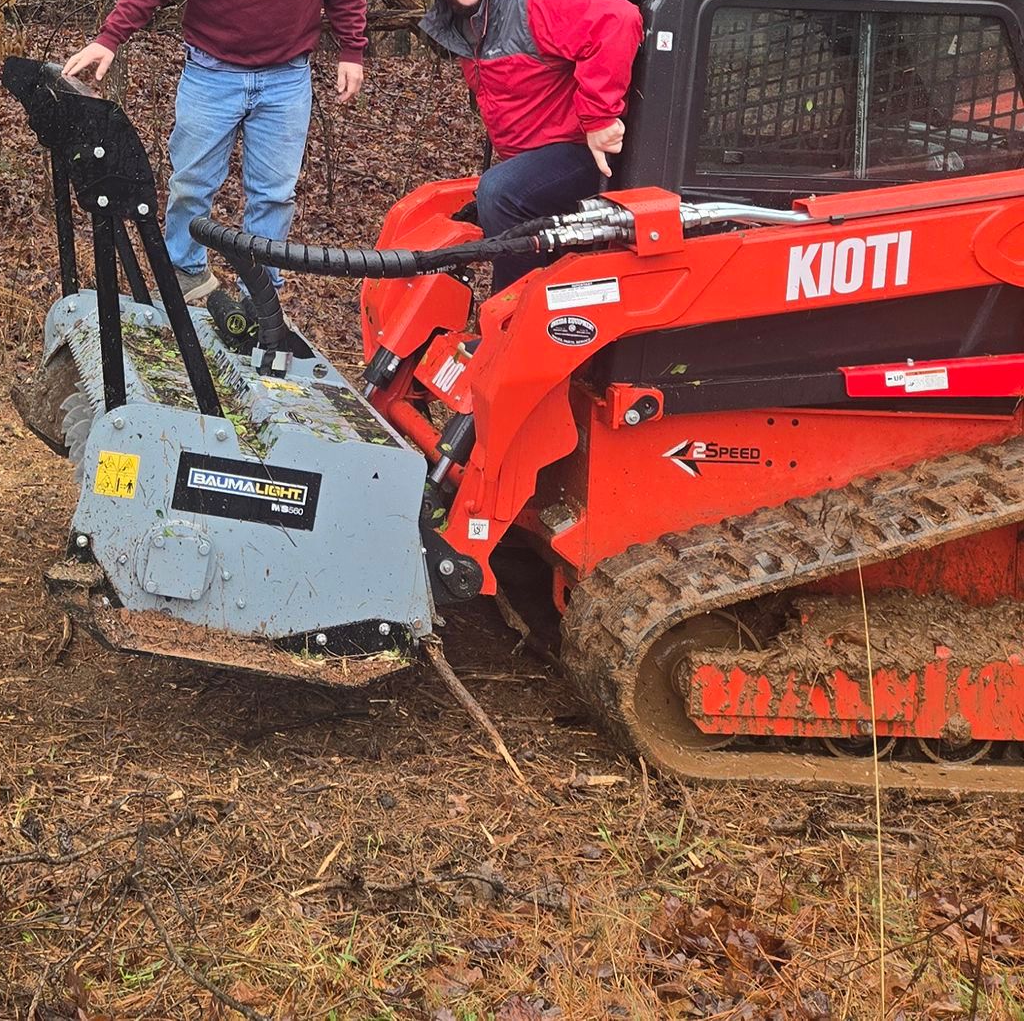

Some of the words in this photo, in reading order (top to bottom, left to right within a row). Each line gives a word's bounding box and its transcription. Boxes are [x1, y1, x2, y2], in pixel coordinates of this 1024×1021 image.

[786, 230, 912, 301] KIOTI
[432, 355, 466, 395] KIO
[193, 473, 303, 501] BAUMALIGHT
